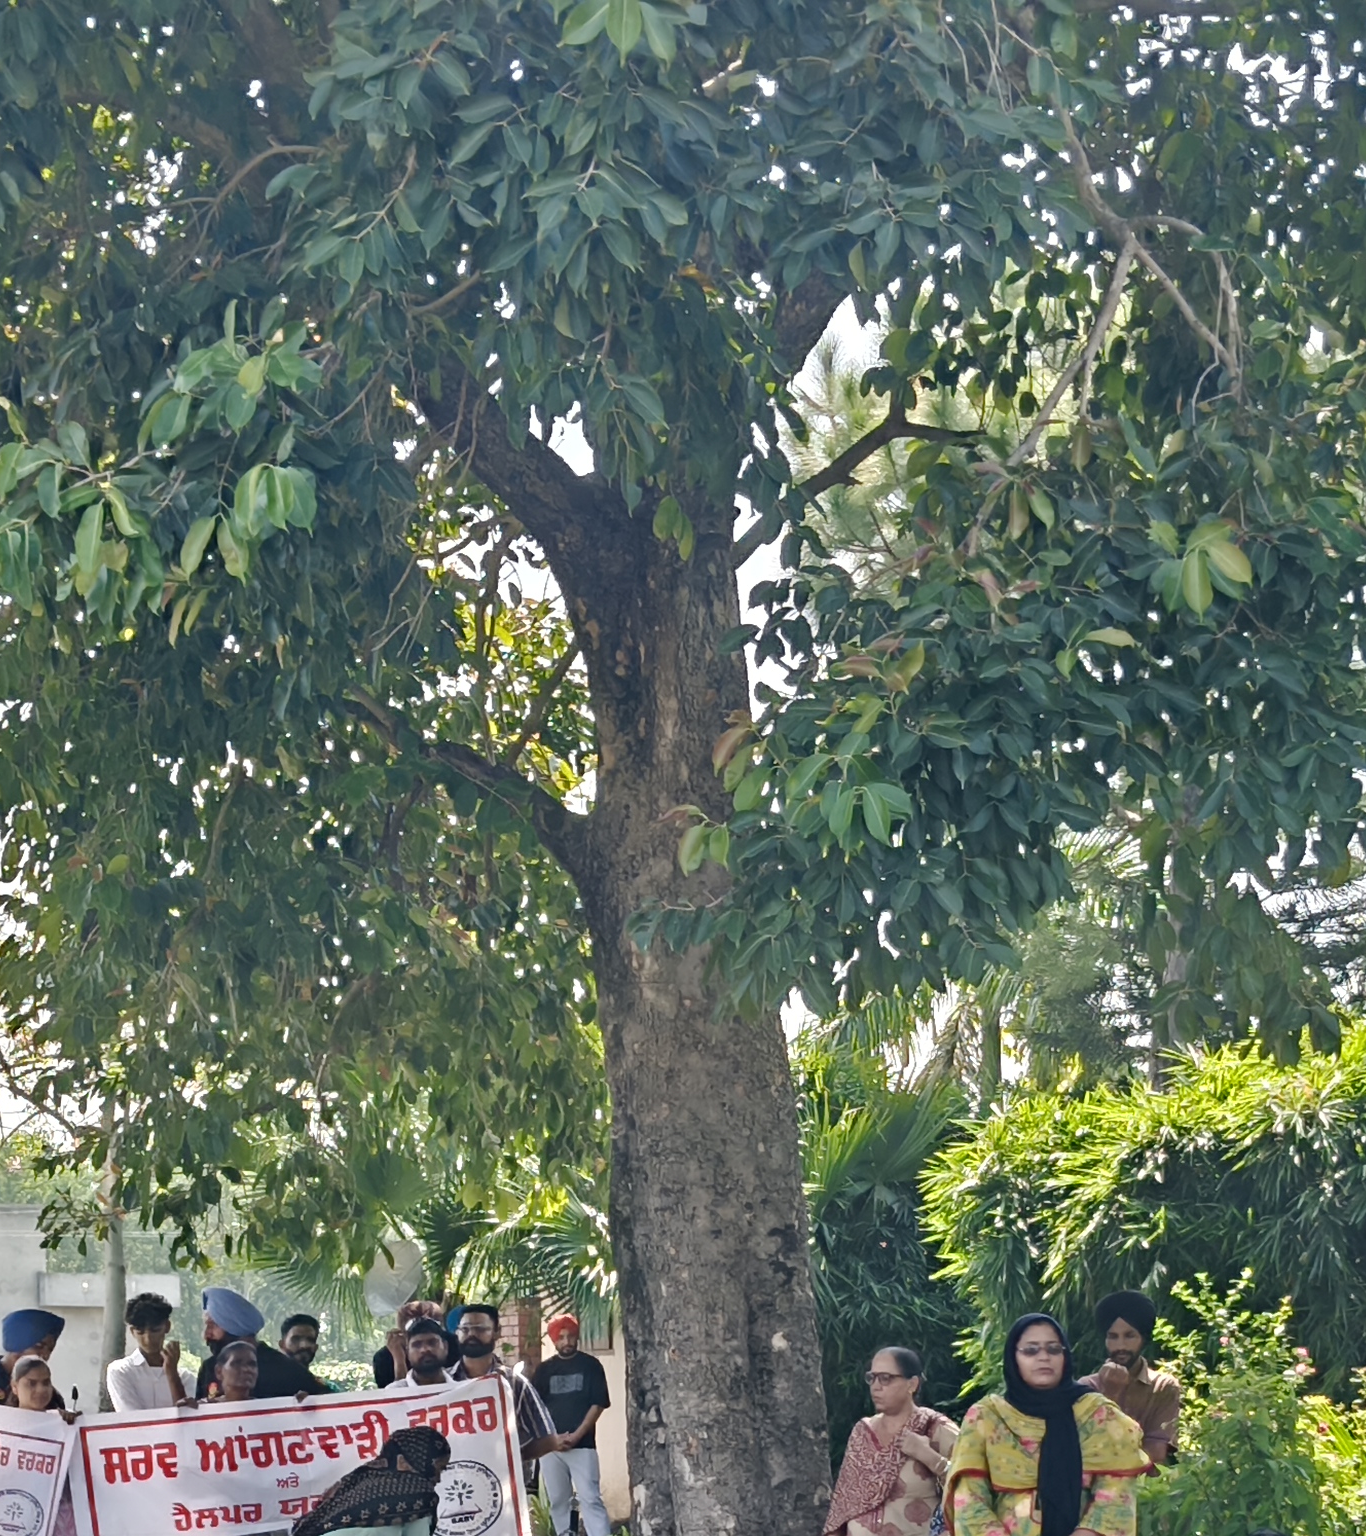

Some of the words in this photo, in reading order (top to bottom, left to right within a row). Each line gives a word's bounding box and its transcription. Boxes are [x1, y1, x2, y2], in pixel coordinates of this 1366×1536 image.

[100, 1442, 178, 1484] ਸਰਵ
[276, 1471, 300, 1489] ਅਤੇ
[171, 1502, 263, 1532] ਹੈਲਪਰ
